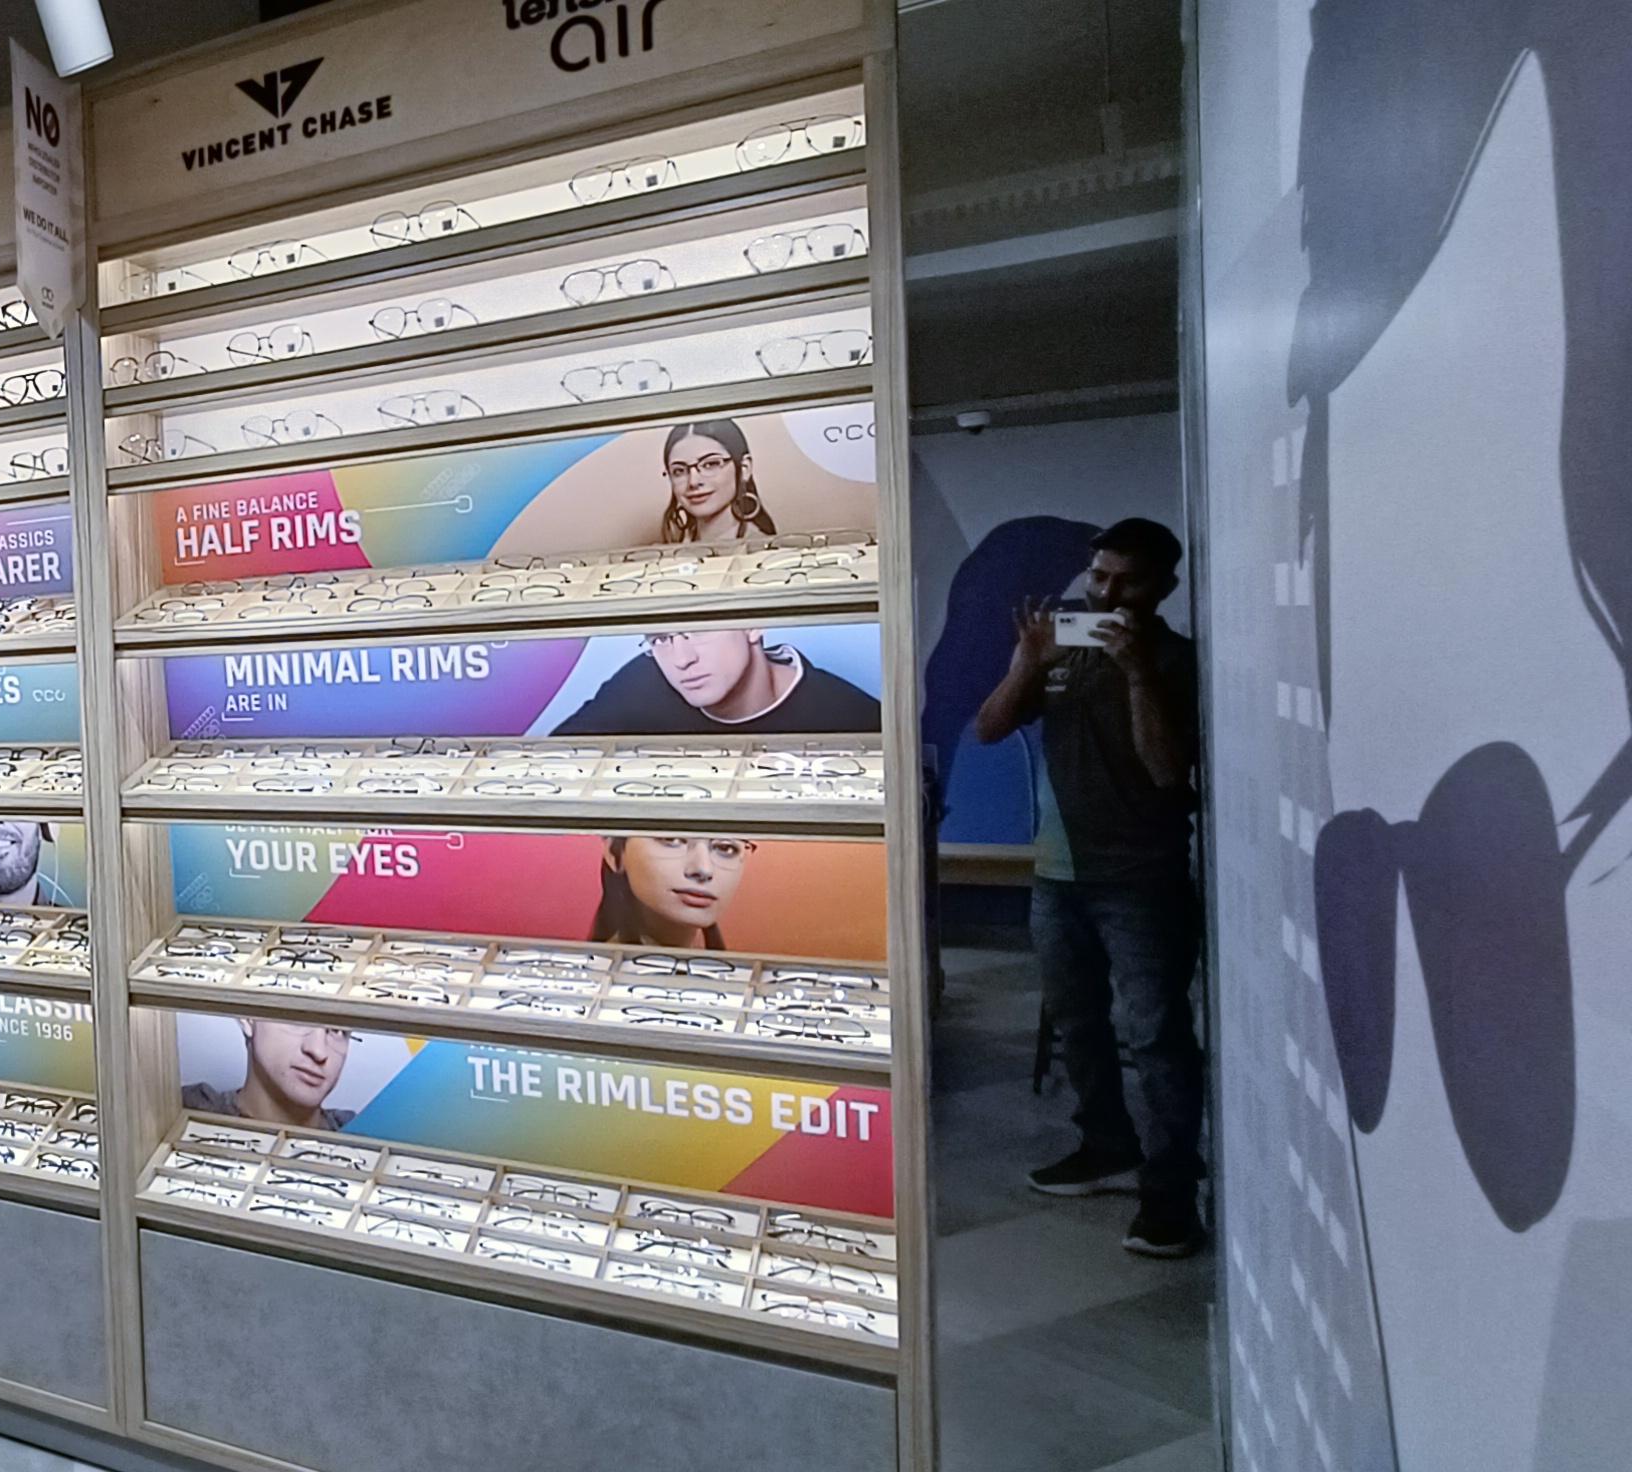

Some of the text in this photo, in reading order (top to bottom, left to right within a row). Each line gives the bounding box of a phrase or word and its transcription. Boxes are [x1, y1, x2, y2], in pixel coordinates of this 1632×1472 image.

[551, 0, 666, 72] air
[182, 95, 392, 171] VINCENT CHASE
[23, 207, 35, 224] WE
[36, 214, 47, 231] DO
[47, 221, 54, 234] IT
[176, 491, 318, 523] A FINE BALANCE
[176, 509, 362, 559] HALF RIMS
[224, 644, 489, 688] MINIMAL RIMS
[225, 693, 287, 712] ARE IN
[226, 838, 419, 878] YOUR EYES
[34, 1021, 73, 1041] 1936
[467, 1055, 879, 1141] THE RIMLESS EDIT
